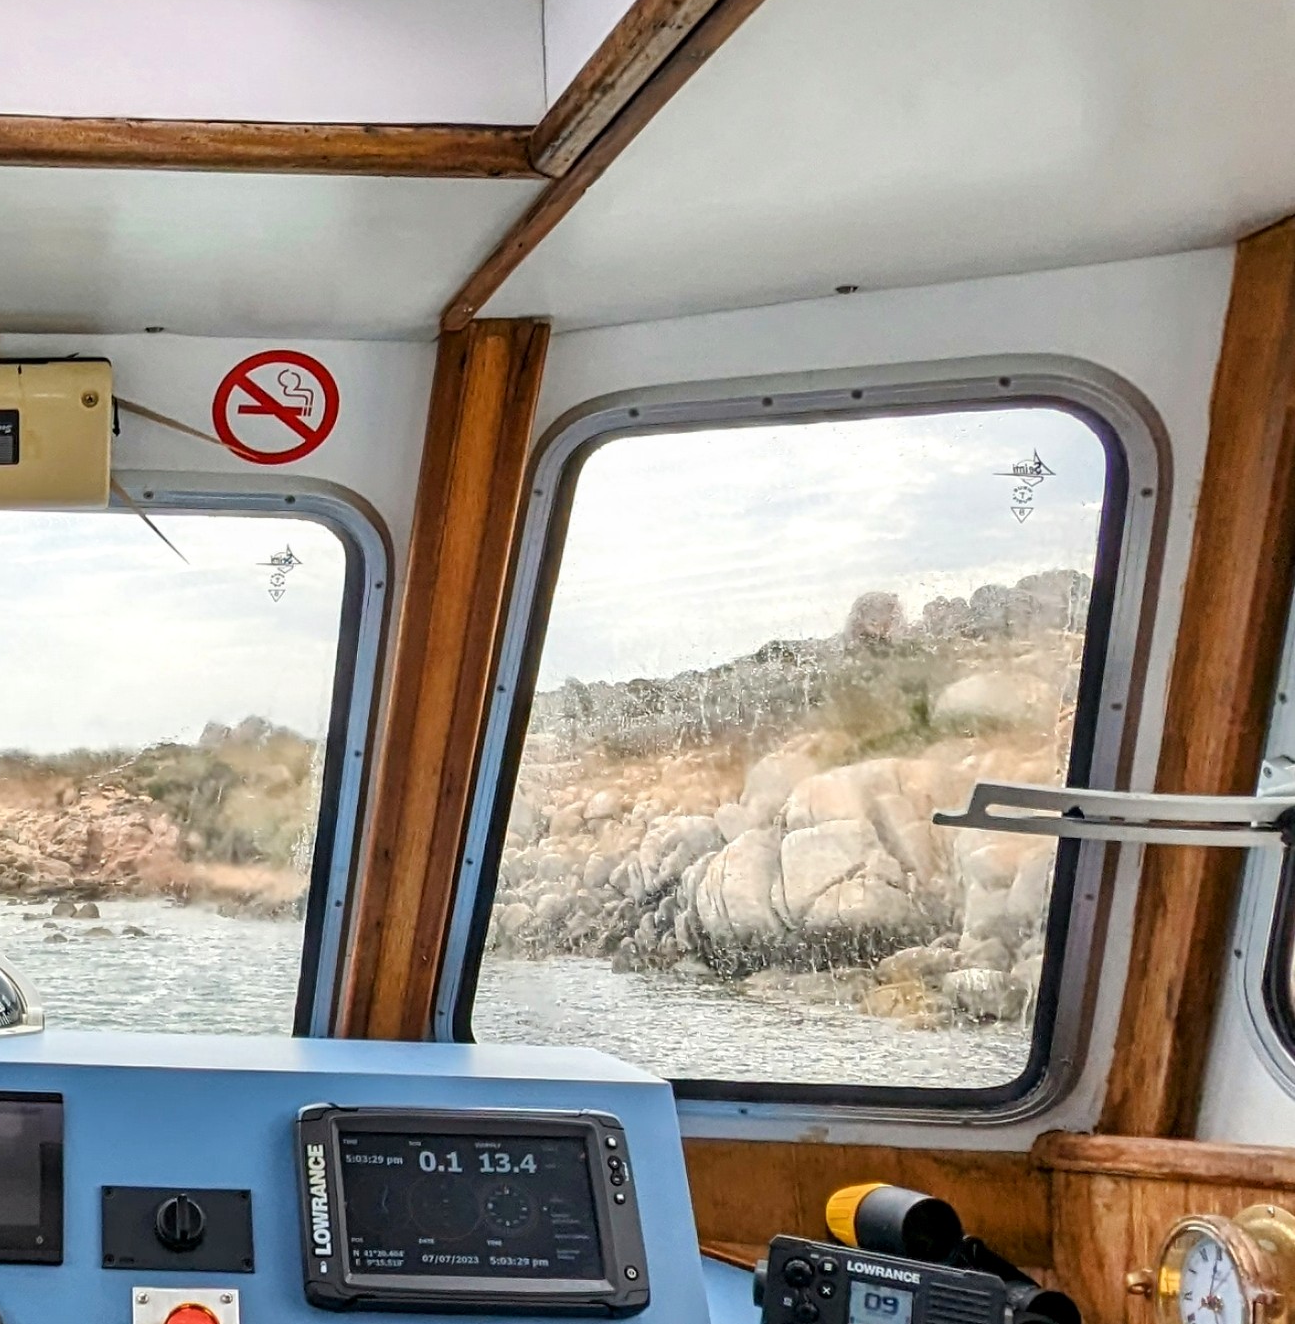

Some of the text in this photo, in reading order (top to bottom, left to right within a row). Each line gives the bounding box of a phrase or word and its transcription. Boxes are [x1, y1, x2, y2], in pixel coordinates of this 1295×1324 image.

[346, 1154, 403, 1166] 5:03:29 pm
[419, 1150, 463, 1173] 0.1
[478, 1153, 537, 1174] 13.4
[306, 1144, 332, 1256] LOWRANCE
[421, 1254, 480, 1265] 07/07/2023
[532, 1258, 549, 1269] pm
[846, 1260, 921, 1285] LOWRANCE
[864, 1292, 899, 1316] 09
